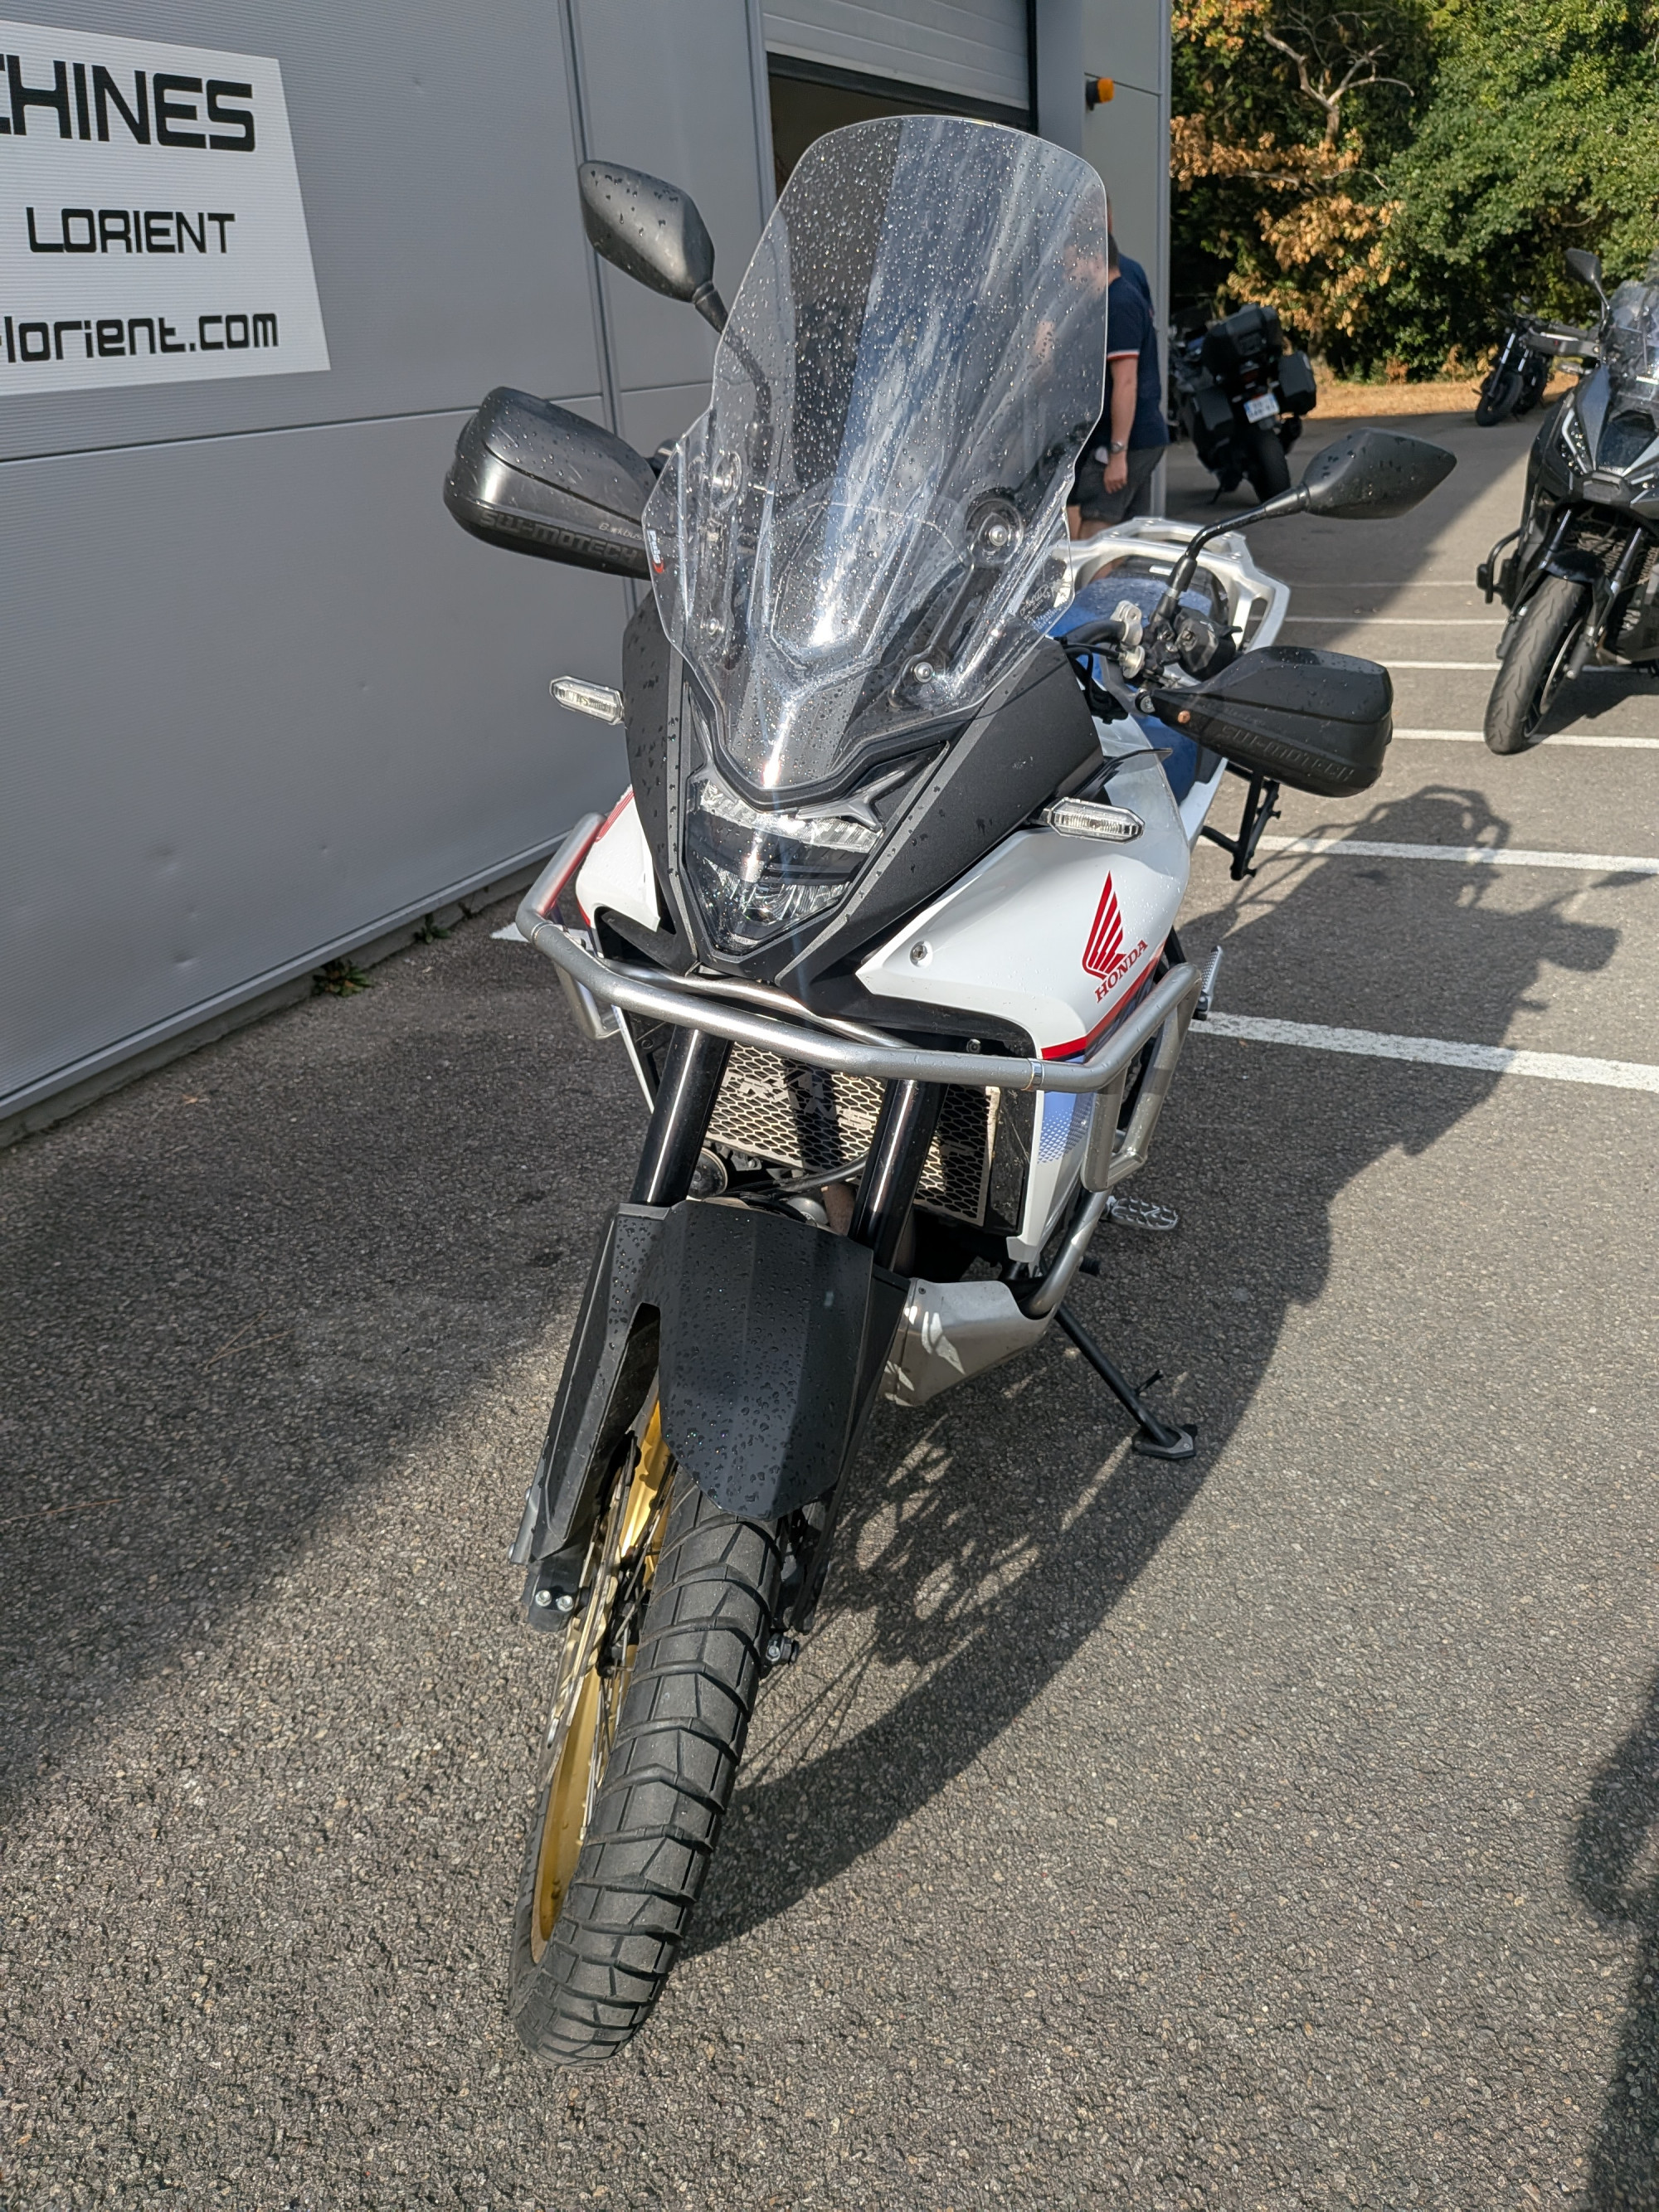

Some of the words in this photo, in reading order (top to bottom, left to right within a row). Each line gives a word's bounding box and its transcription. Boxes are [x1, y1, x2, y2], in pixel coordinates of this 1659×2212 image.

[0, 54, 255, 152] HINES
[26, 207, 236, 254] LORIENT
[0, 312, 280, 363] lorient.com
[479, 508, 638, 565] SW-MOTECH
[1094, 940, 1148, 1004] HONDA
